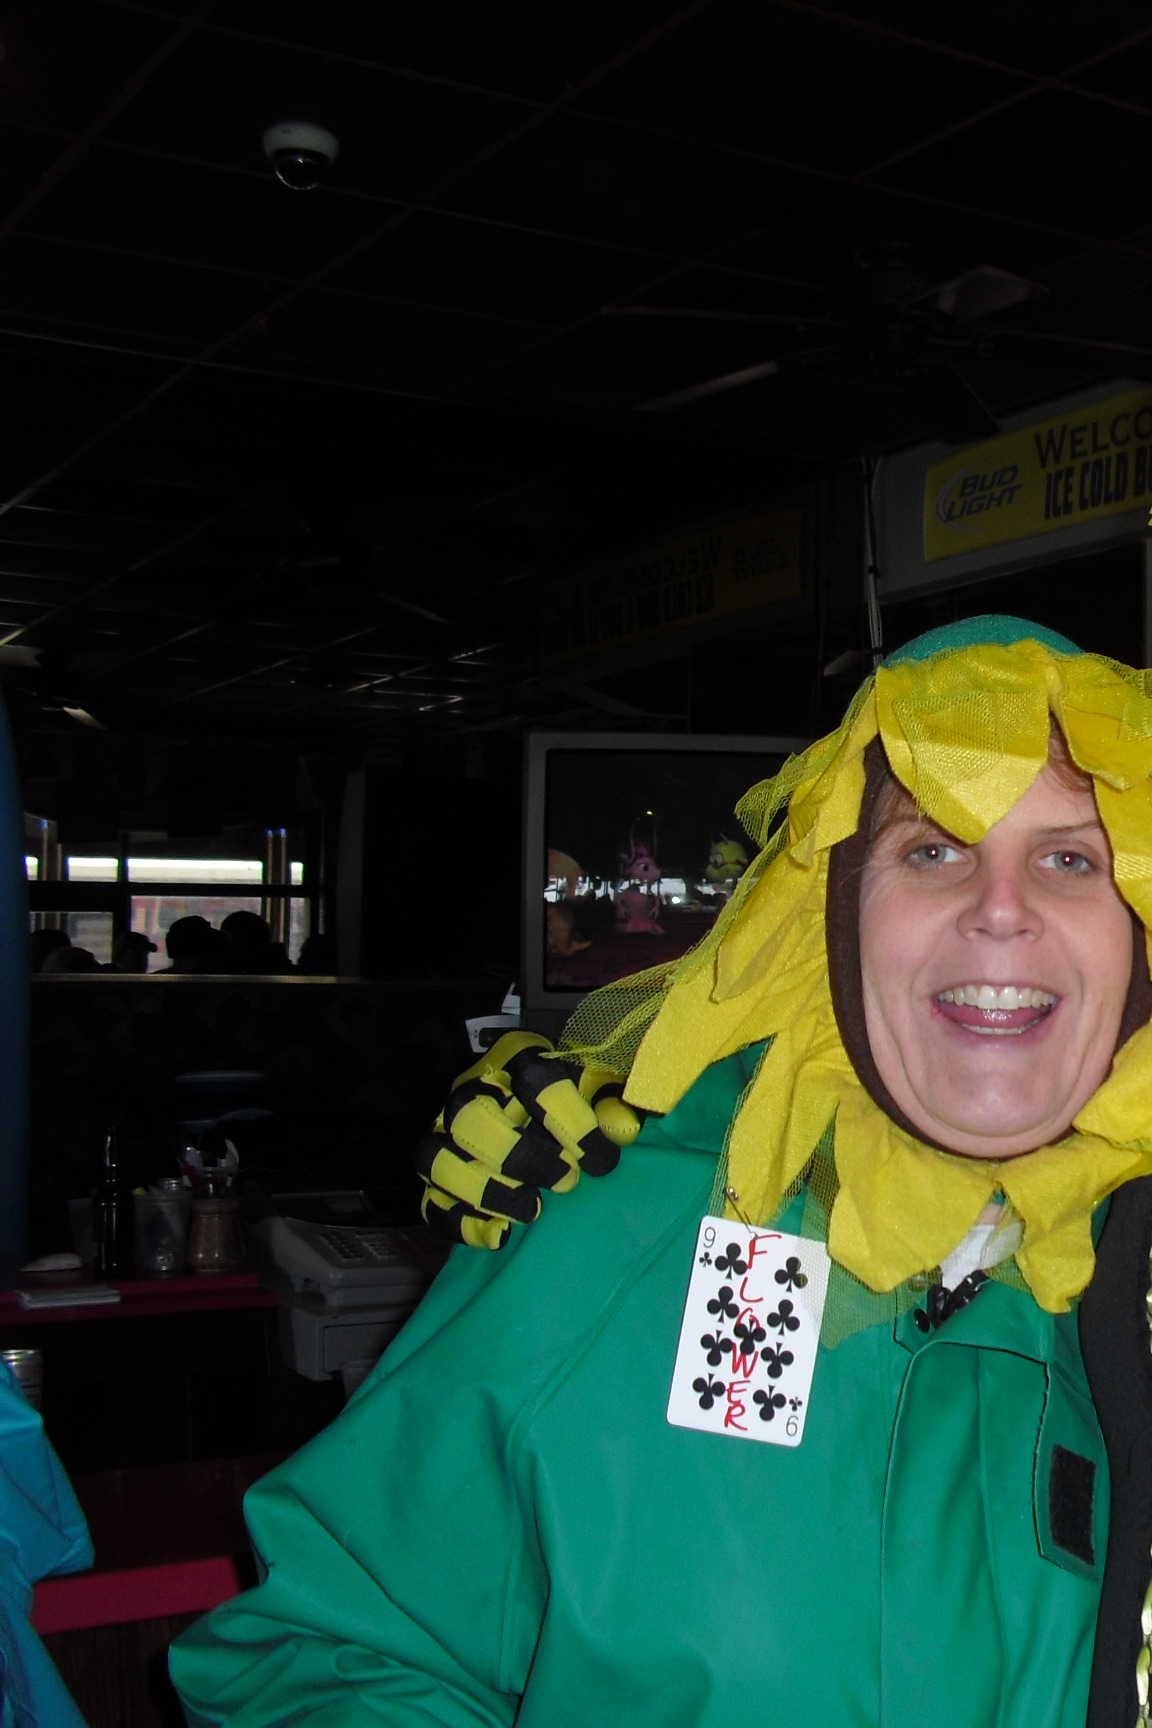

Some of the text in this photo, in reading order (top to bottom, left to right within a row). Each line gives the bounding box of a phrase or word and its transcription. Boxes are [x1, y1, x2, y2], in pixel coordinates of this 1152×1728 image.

[958, 465, 1018, 498] BUD
[1044, 466, 1075, 520] ICE
[1079, 451, 1129, 511] COLD
[944, 484, 1022, 522] LIGHT
[703, 1227, 716, 1249] 9
[723, 1234, 783, 1431] FLOWER
[785, 1416, 799, 1437] 9
